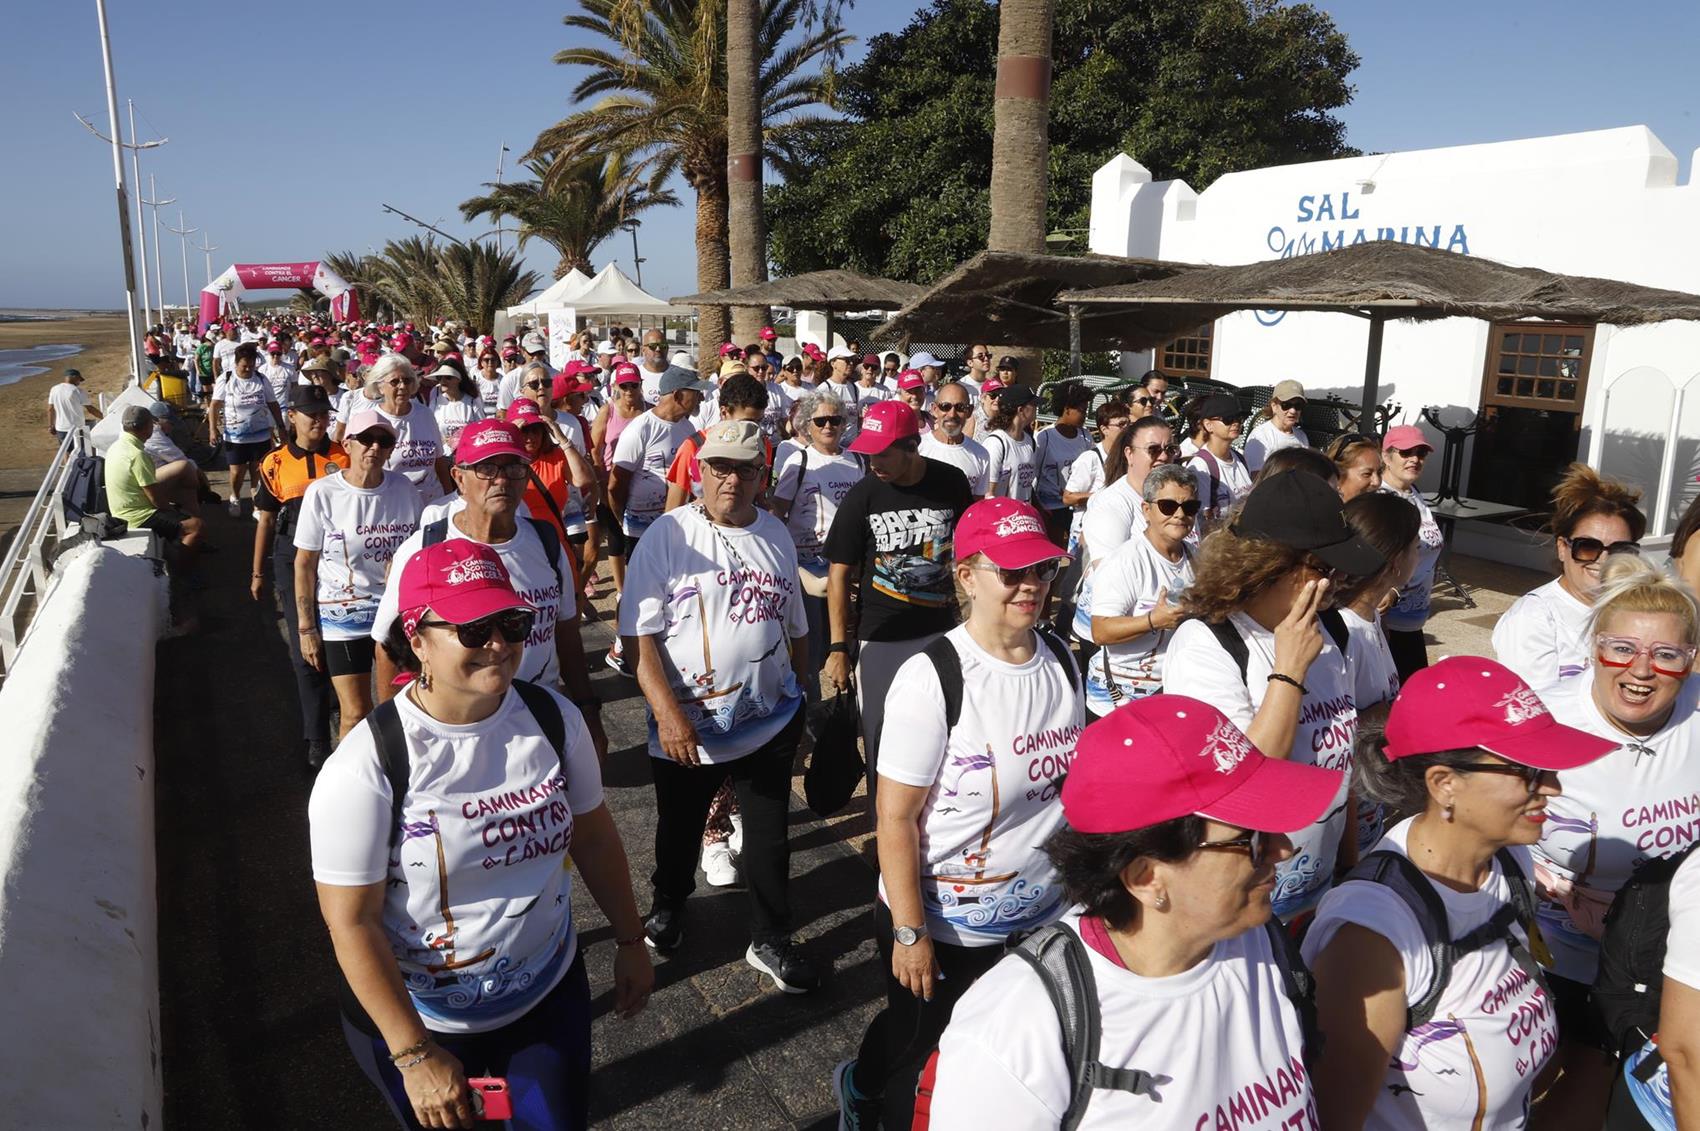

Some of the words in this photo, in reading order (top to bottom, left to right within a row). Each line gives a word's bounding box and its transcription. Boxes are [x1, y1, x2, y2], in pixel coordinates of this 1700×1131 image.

[1297, 191, 1360, 223] SAL
[869, 508, 945, 535] BACK
[364, 535, 409, 550] CONTR
[875, 534, 889, 544] TO
[1026, 788, 1040, 801] EL
[482, 856, 502, 871] EL
[504, 822, 573, 867] CÁNCE
[1515, 1057, 1529, 1078] EL
